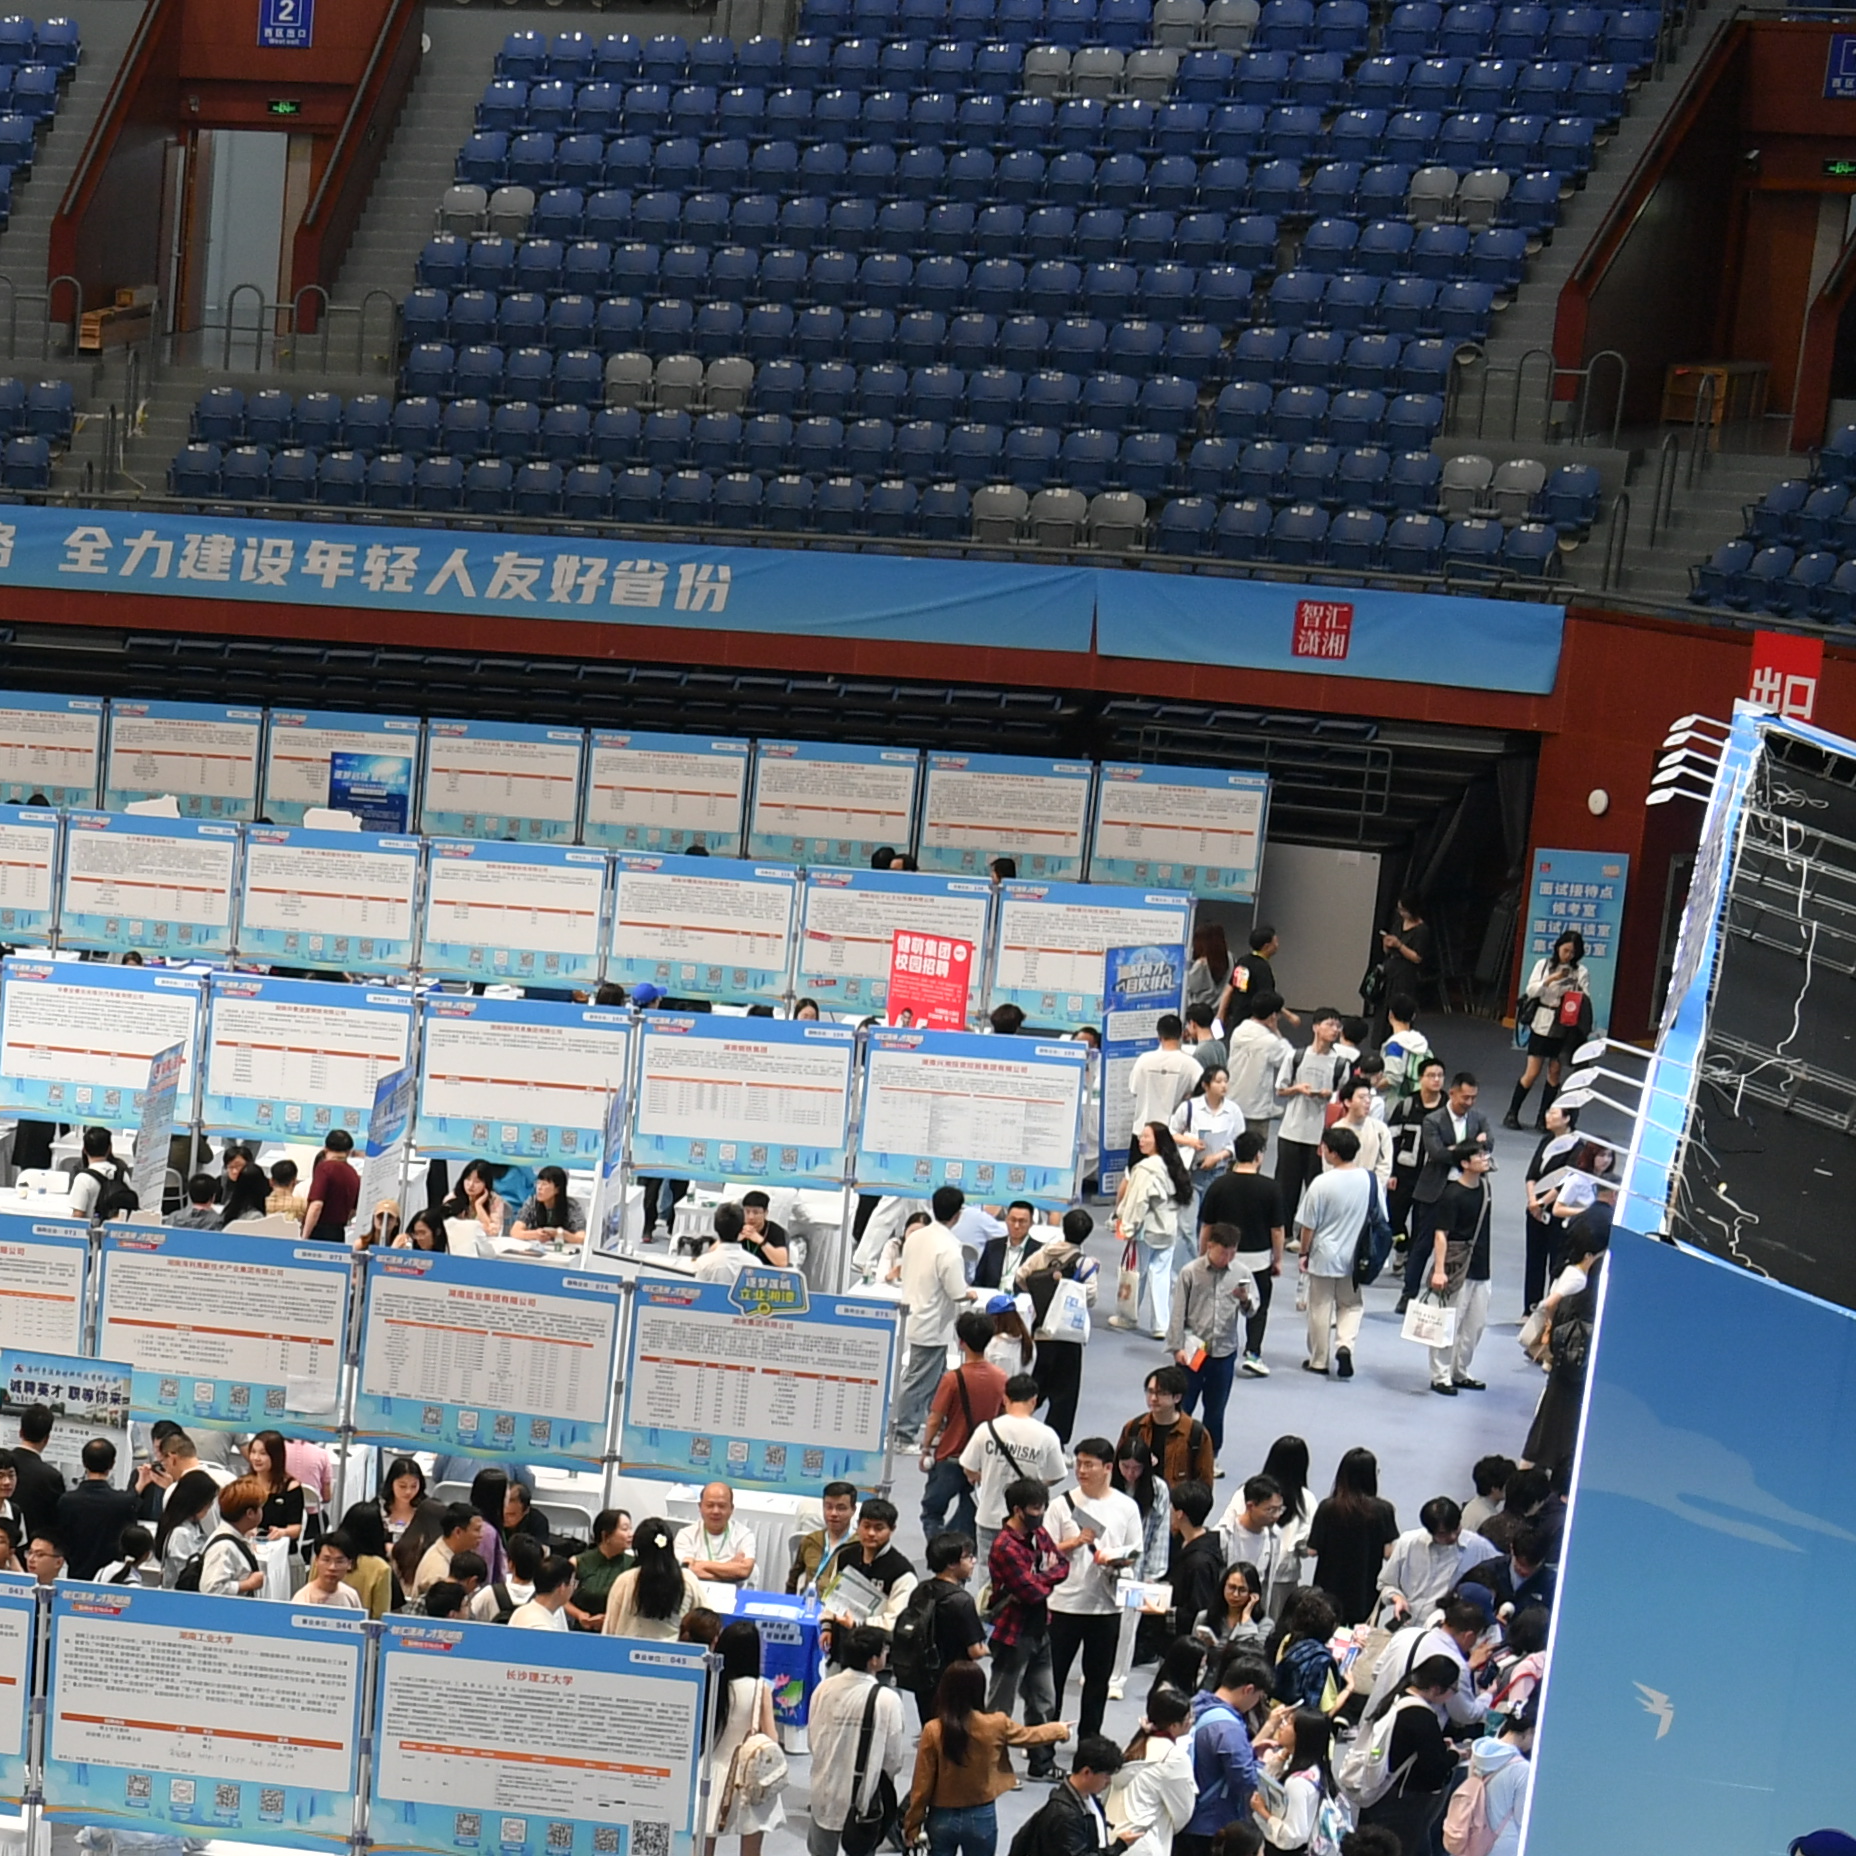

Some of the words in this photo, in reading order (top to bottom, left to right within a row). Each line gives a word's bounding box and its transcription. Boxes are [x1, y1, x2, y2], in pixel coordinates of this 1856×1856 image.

[277, 0, 295, 21] 2
[59, 527, 731, 615] 全力建设年轻人友好省份
[1298, 600, 1352, 629] 智汇
[1298, 629, 1350, 659] 潇湘
[1750, 667, 1816, 720] 出口
[10, 1379, 64, 1399] 诚聘英才
[68, 1385, 122, 1406] 职等你来
[178, 1631, 233, 1644] 湖南工业大学
[506, 1669, 573, 1685] 长沙理工大学
